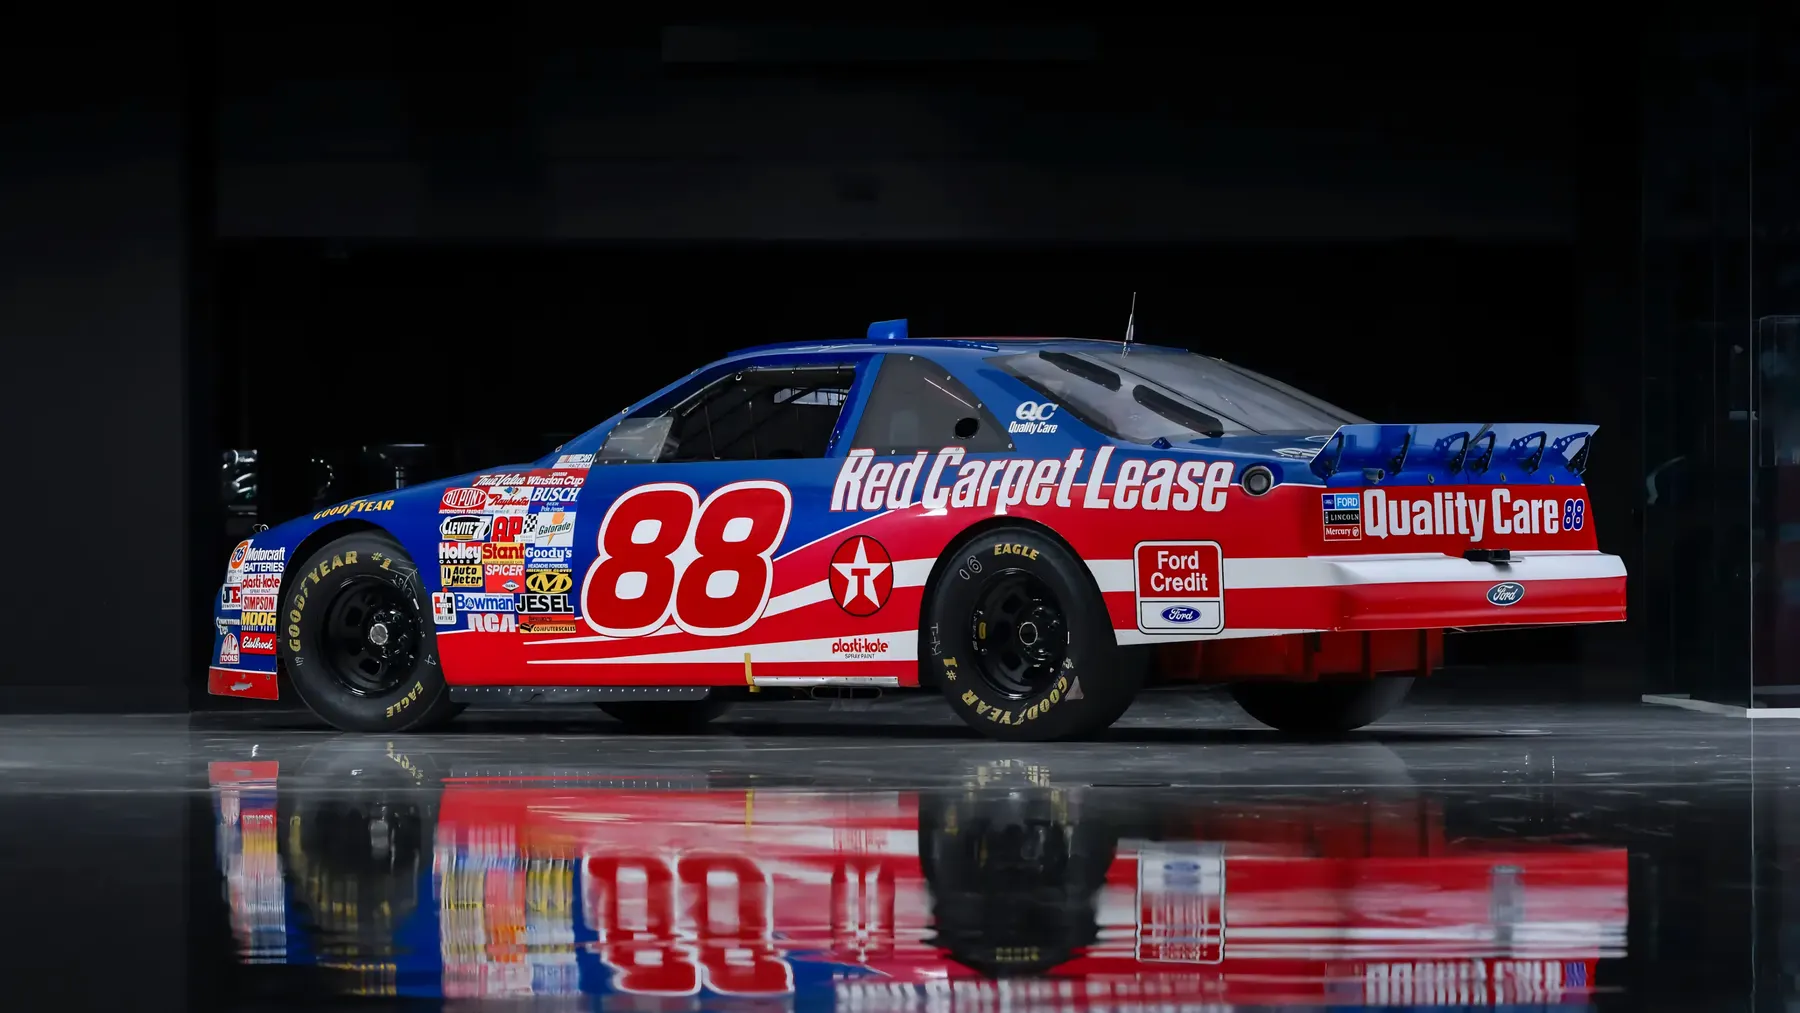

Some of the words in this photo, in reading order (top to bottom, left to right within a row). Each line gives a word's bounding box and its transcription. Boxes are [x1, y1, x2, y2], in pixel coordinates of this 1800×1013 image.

[1015, 401, 1059, 421] QC
[1008, 421, 1038, 435] Quality
[1039, 421, 1058, 433] Care
[527, 476, 564, 487] Winston
[564, 476, 585, 487] Cup
[831, 447, 926, 512] Red
[922, 446, 1086, 515] Carpet
[1083, 446, 1236, 512] Lease
[532, 488, 581, 502] BUSCH
[1337, 498, 1358, 507] FORD
[1363, 488, 1486, 542] Quality
[1491, 488, 1559, 535] Care
[1563, 498, 1585, 532] 88
[491, 516, 524, 542] AP
[538, 522, 572, 535] Gatorade
[1326, 528, 1351, 536] Mercury
[232, 546, 245, 562] 76
[246, 547, 285, 561] Motorcraft
[439, 542, 482, 564] Holley
[482, 543, 525, 559] Stant
[525, 547, 572, 562] Goody's
[581, 480, 792, 638] 88
[994, 543, 1040, 561] EAGLE
[244, 562, 284, 572] BATTERIES
[1157, 550, 1199, 570] Ford
[453, 566, 477, 575] Auto
[486, 565, 523, 577] SPICER
[242, 574, 280, 590] plasti-kote
[451, 574, 482, 585] Meter
[1150, 571, 1208, 592] Credit
[1492, 584, 1519, 602] Ford
[244, 596, 275, 610] SIMPSON
[456, 594, 515, 612] Bowman
[516, 595, 574, 613] JESEL
[241, 612, 276, 627] MOOG
[1168, 607, 1194, 621] Ford
[467, 613, 517, 633] RCA
[242, 636, 274, 650] Edelbrock
[832, 638, 889, 655] plasti-kote
[386, 681, 424, 719] EAGLE
